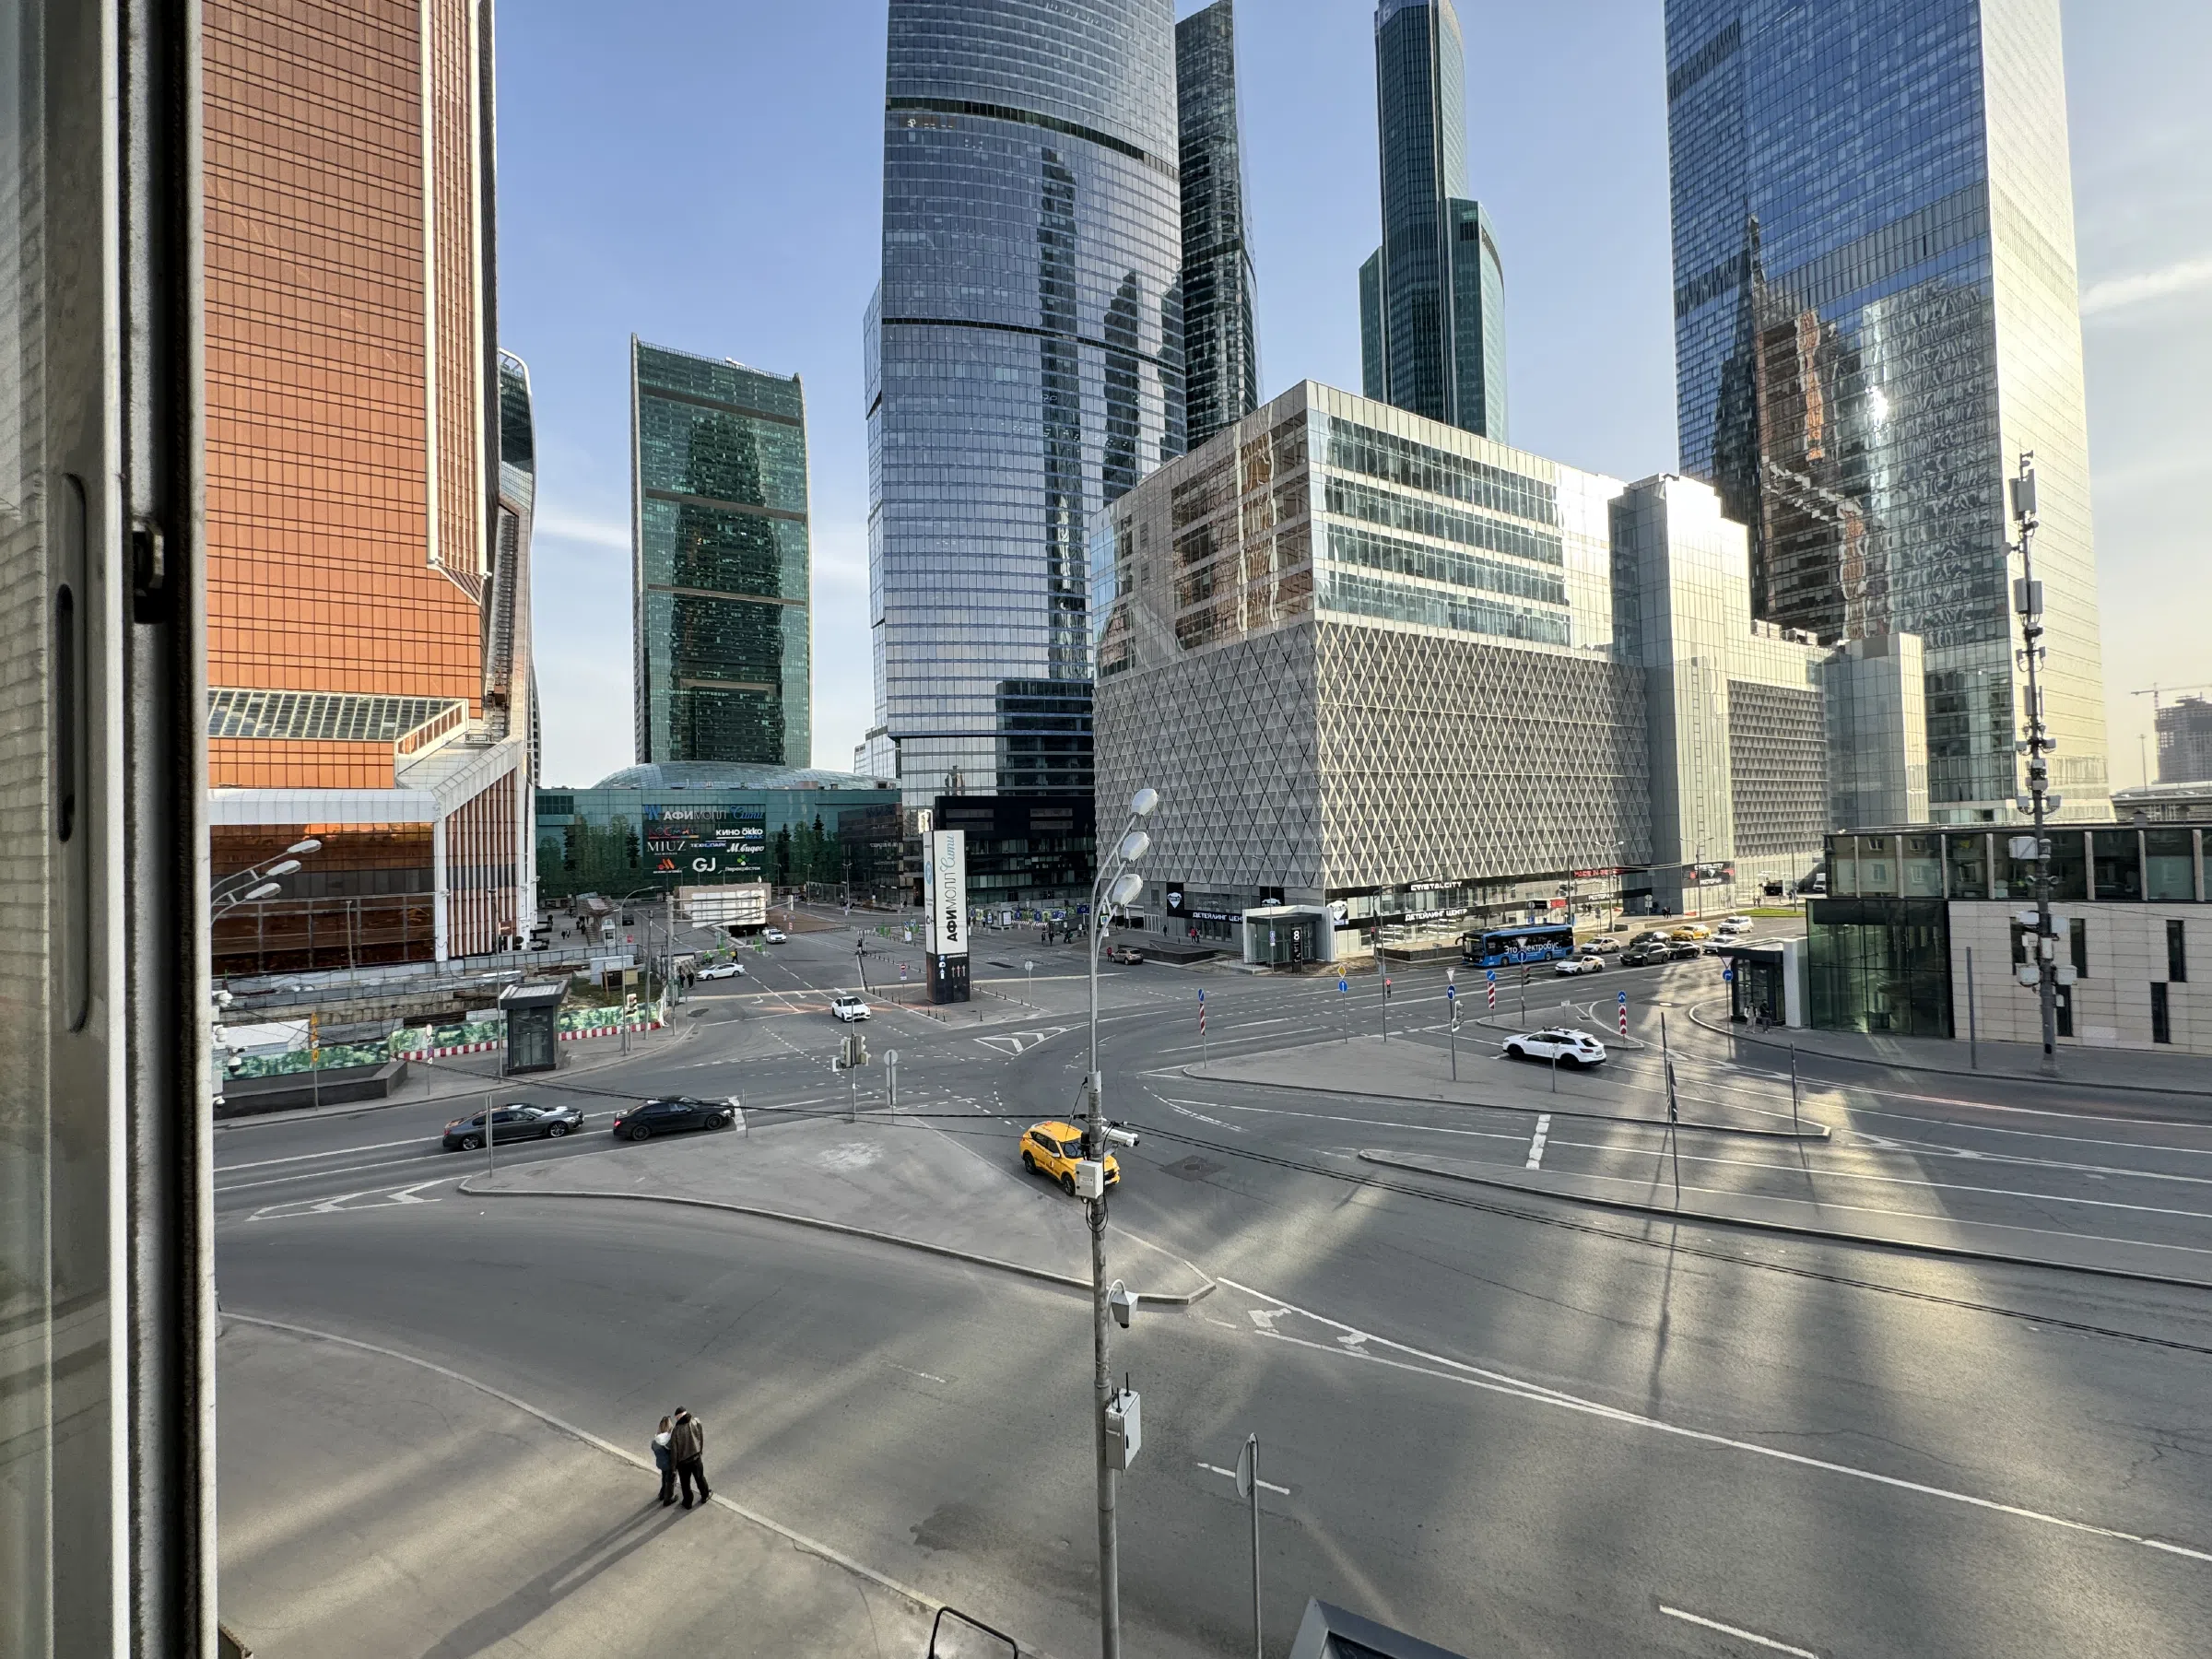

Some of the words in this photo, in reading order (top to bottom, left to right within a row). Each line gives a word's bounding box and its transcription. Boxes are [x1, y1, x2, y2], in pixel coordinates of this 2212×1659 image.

[664, 810, 727, 820] АФИМОЛЛ
[647, 841, 687, 853] MIUZ
[692, 857, 716, 873] GJ
[944, 872, 959, 943] АФИМОЛЛ
[1293, 930, 1300, 940] 8
[1503, 945, 1518, 955] Это
